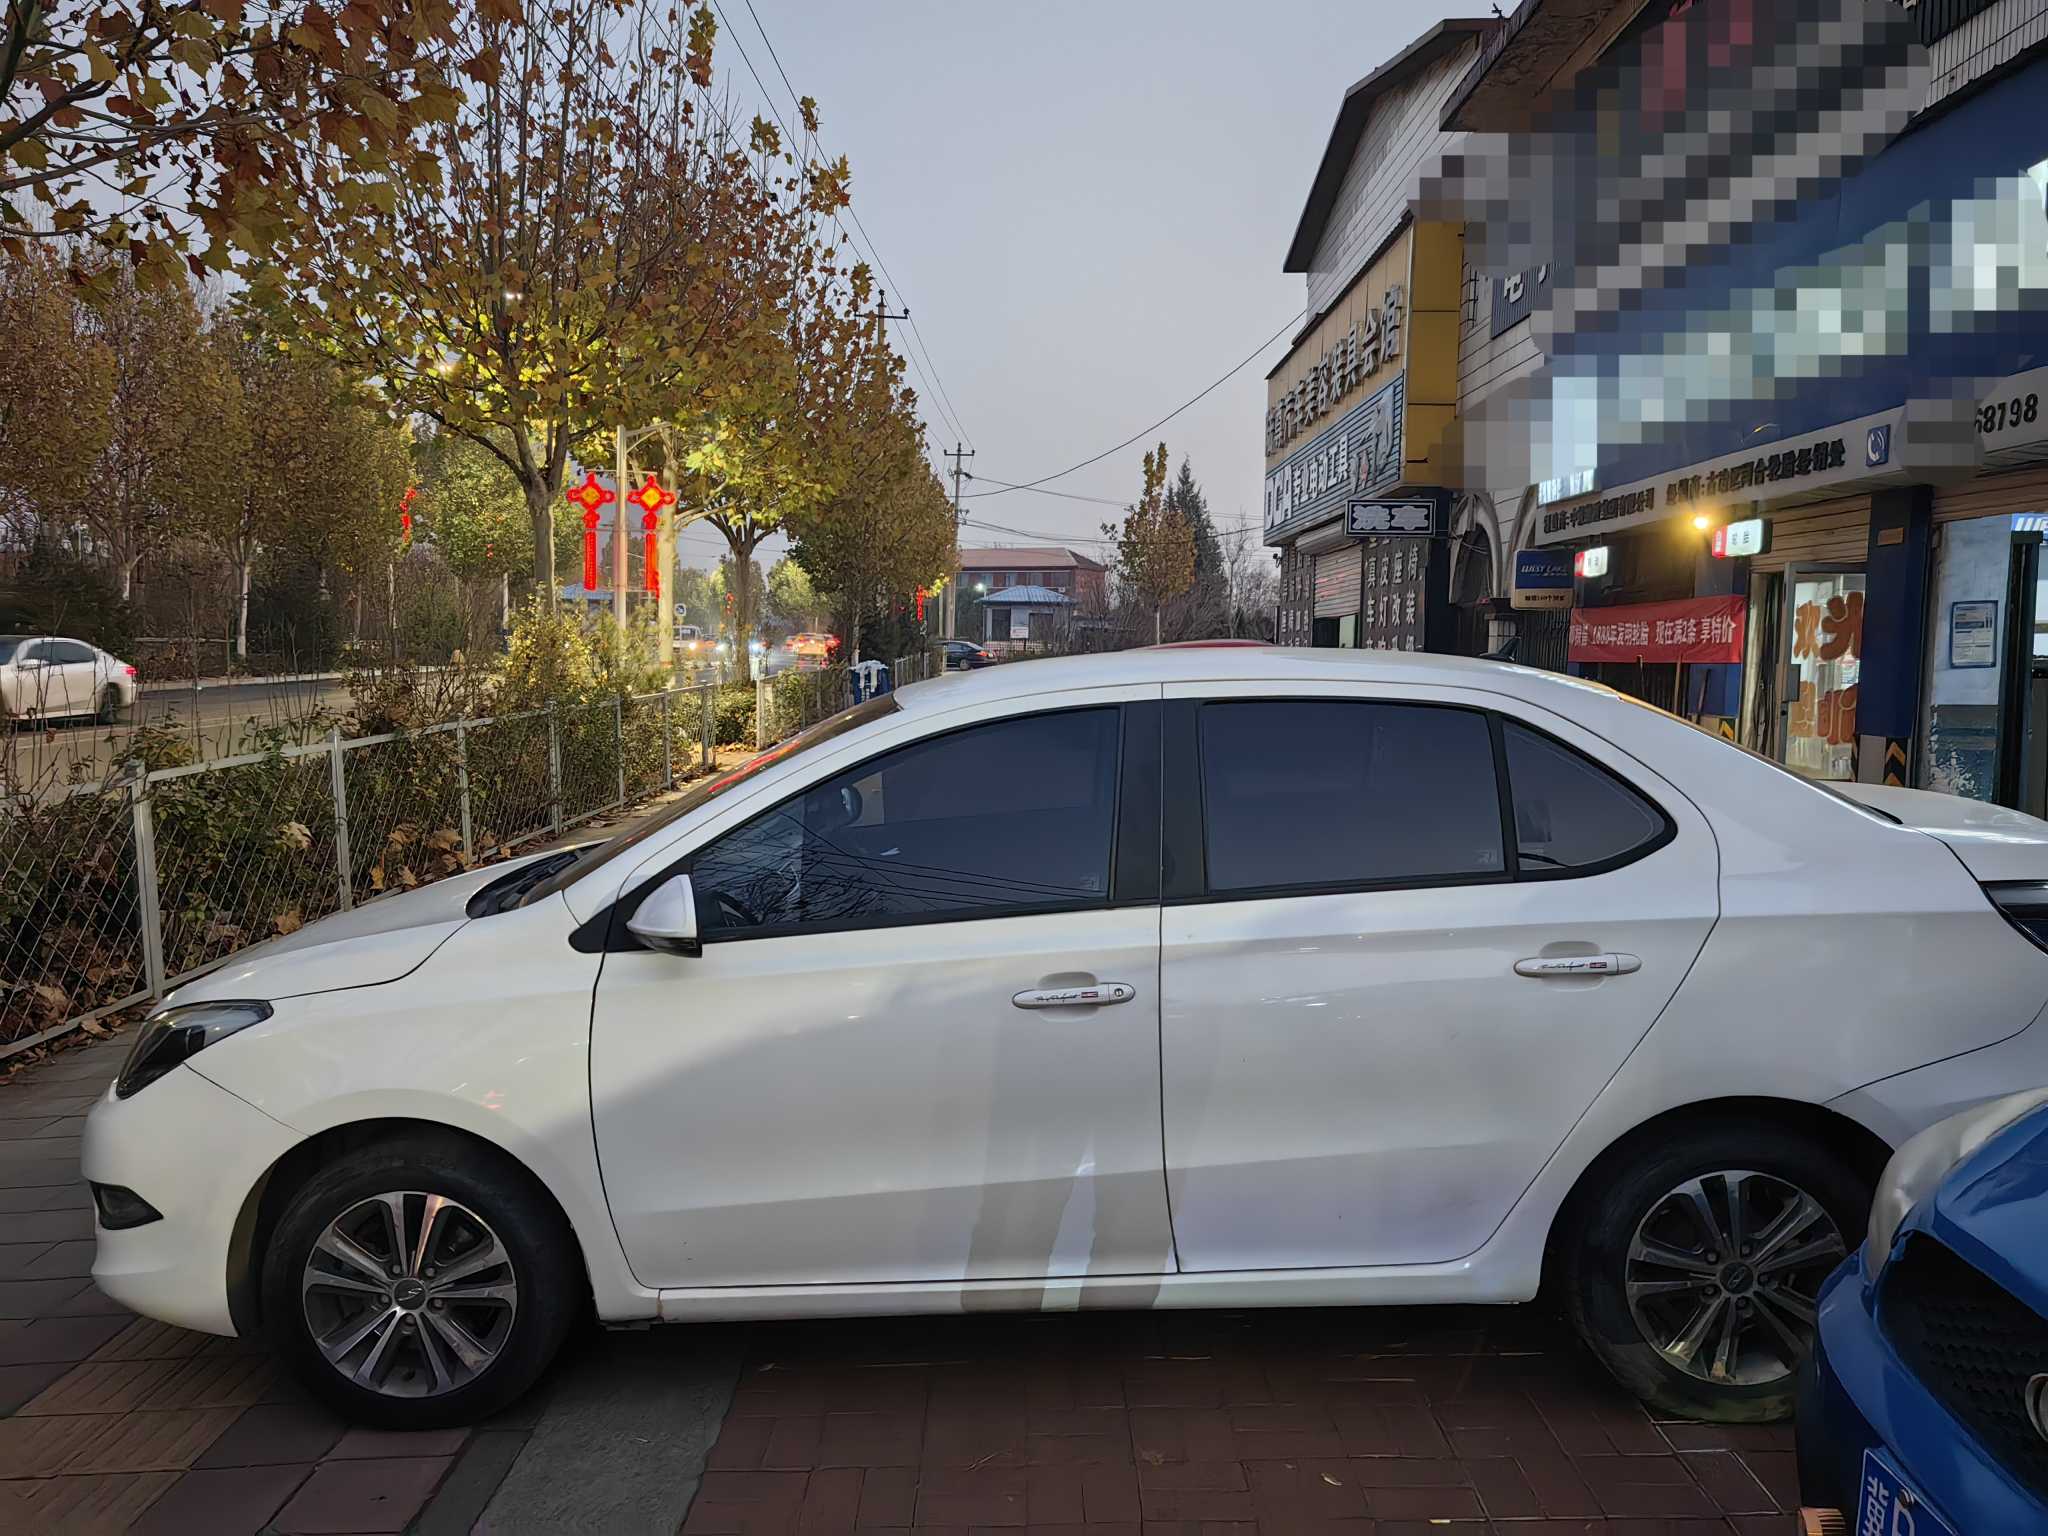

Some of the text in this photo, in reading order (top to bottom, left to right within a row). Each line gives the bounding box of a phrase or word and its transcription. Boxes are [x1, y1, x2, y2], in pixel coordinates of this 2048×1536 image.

[1366, 543, 1418, 588] 真皮座椅
[1365, 589, 1416, 628] 车灯改装
[1655, 617, 1697, 645] 现在满2条
[1700, 614, 1735, 644] 享特价
